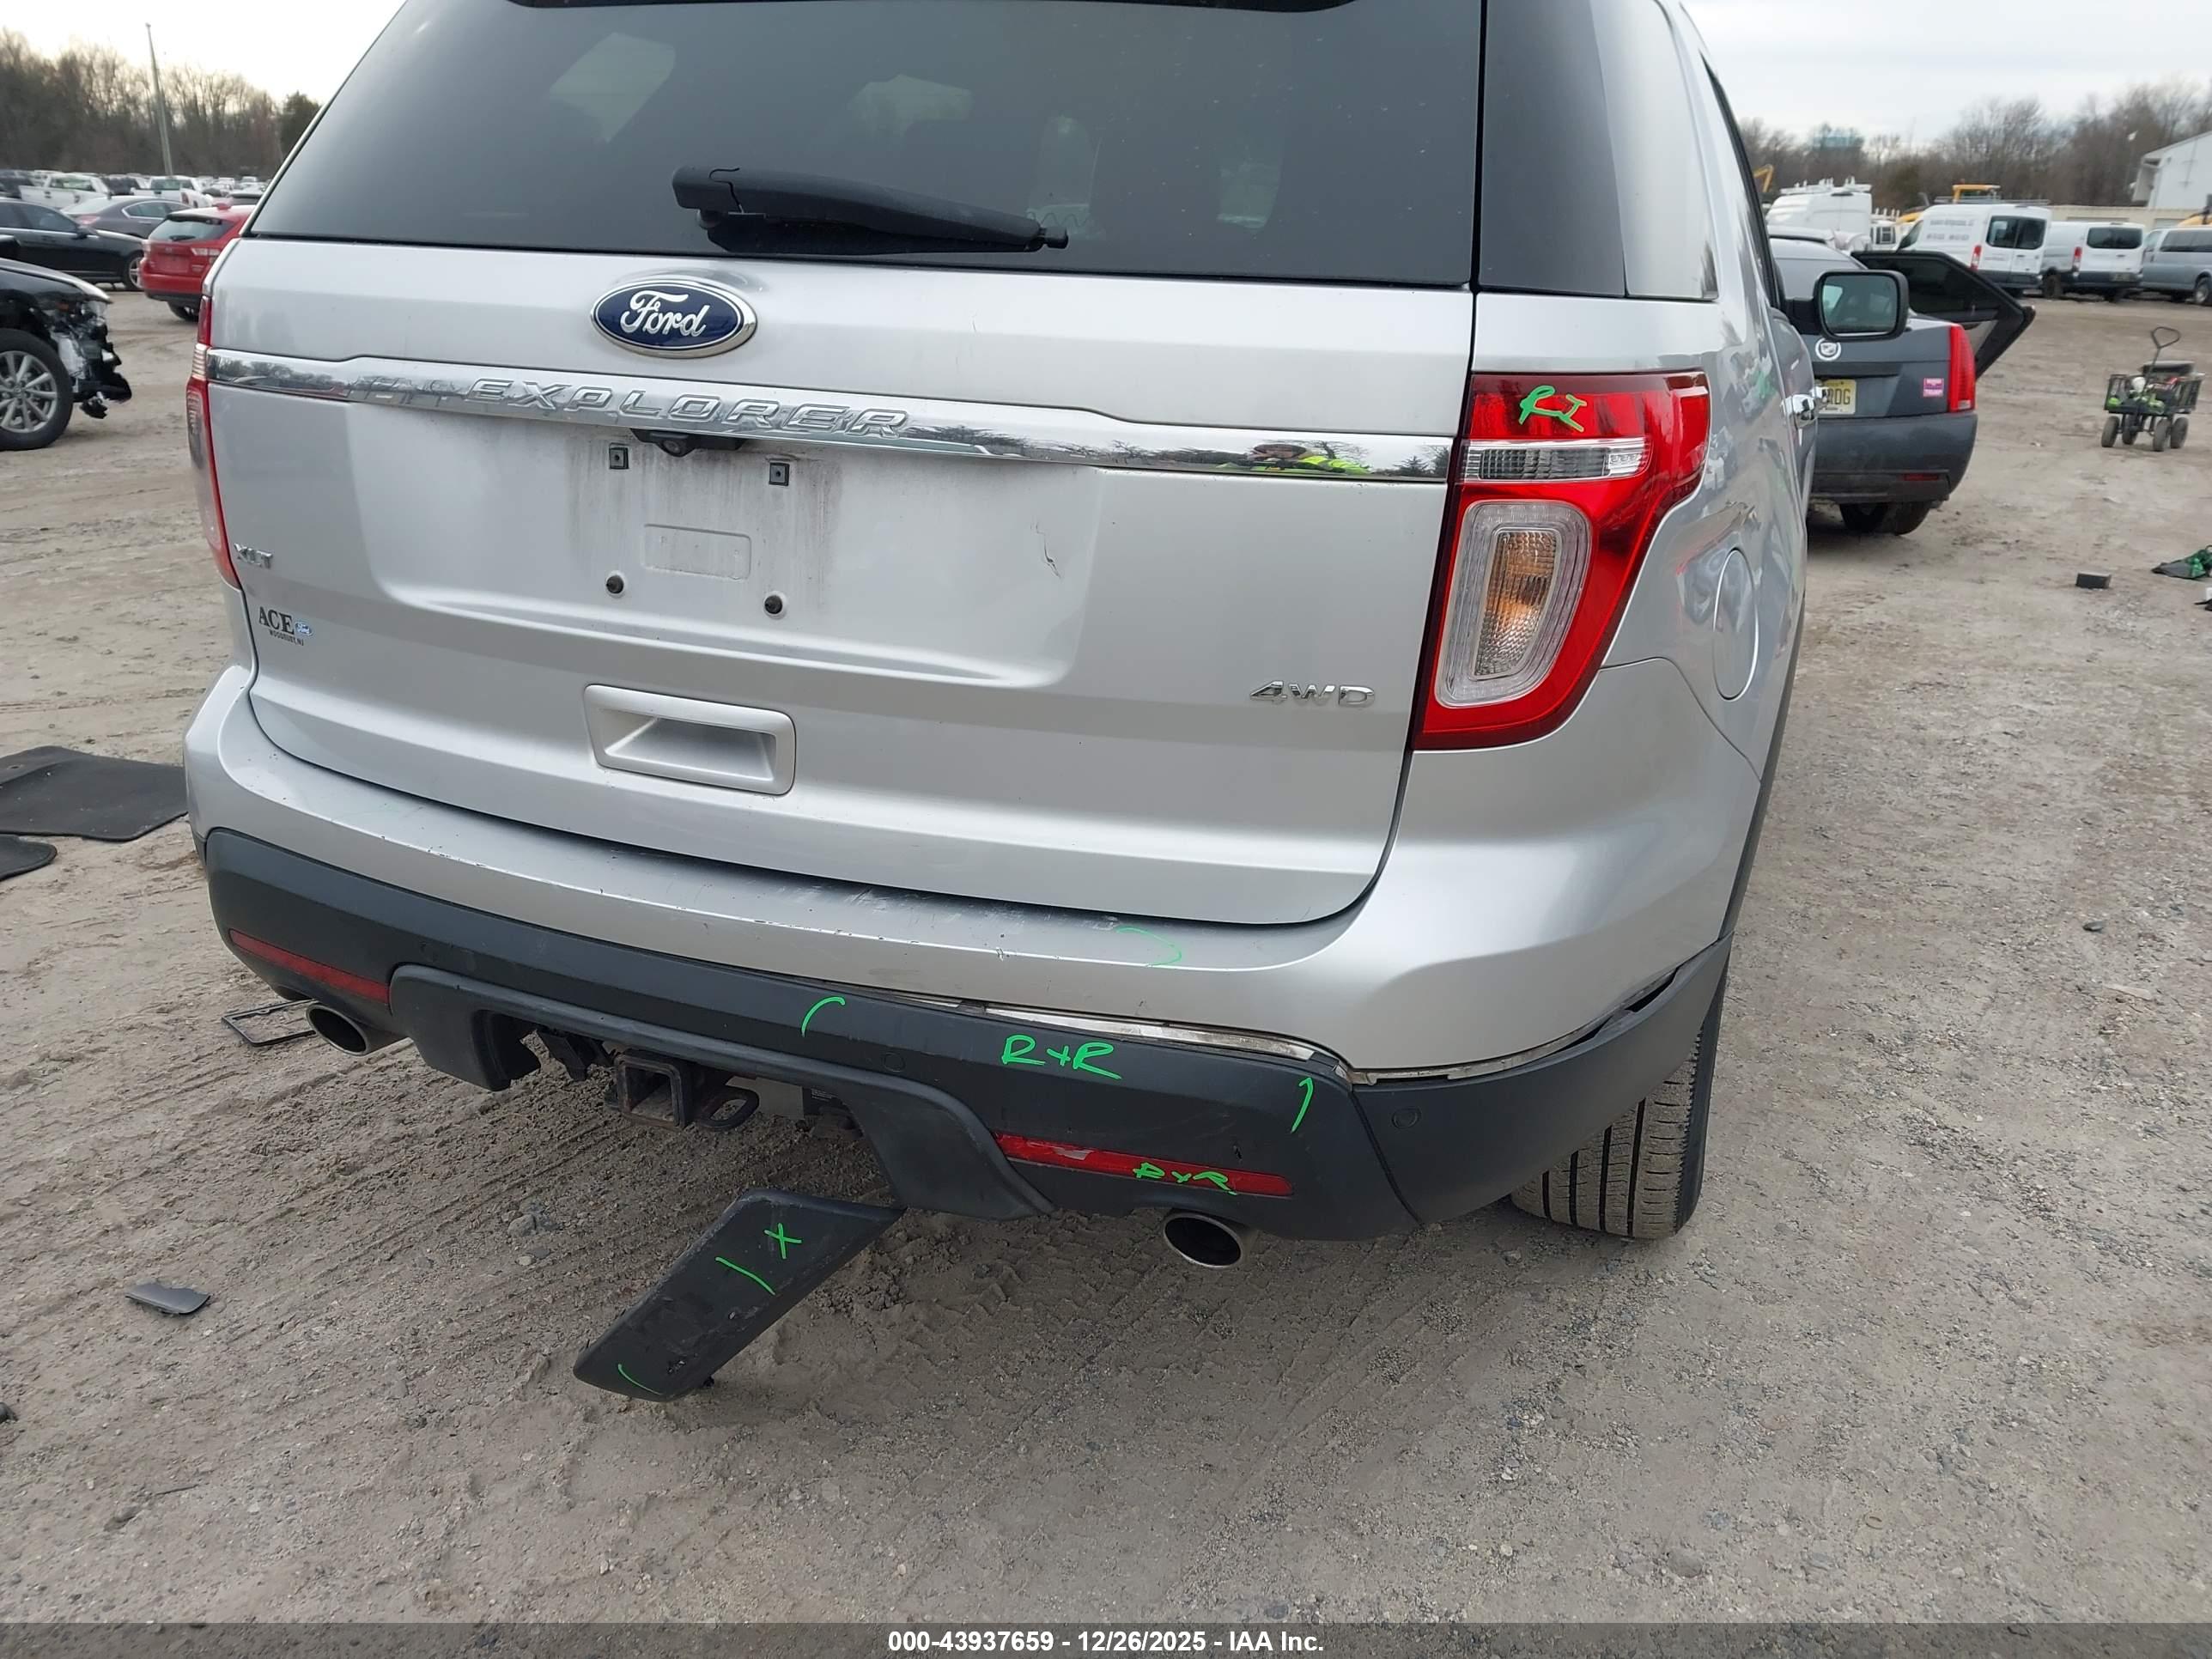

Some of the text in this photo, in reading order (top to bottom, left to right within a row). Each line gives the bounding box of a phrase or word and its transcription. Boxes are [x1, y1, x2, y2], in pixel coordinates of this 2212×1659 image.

[620, 289, 711, 337] Ford
[464, 376, 910, 440] EXPLORER
[234, 543, 274, 569] XLT
[258, 606, 295, 635] ACE
[1249, 680, 1375, 708] 4WD
